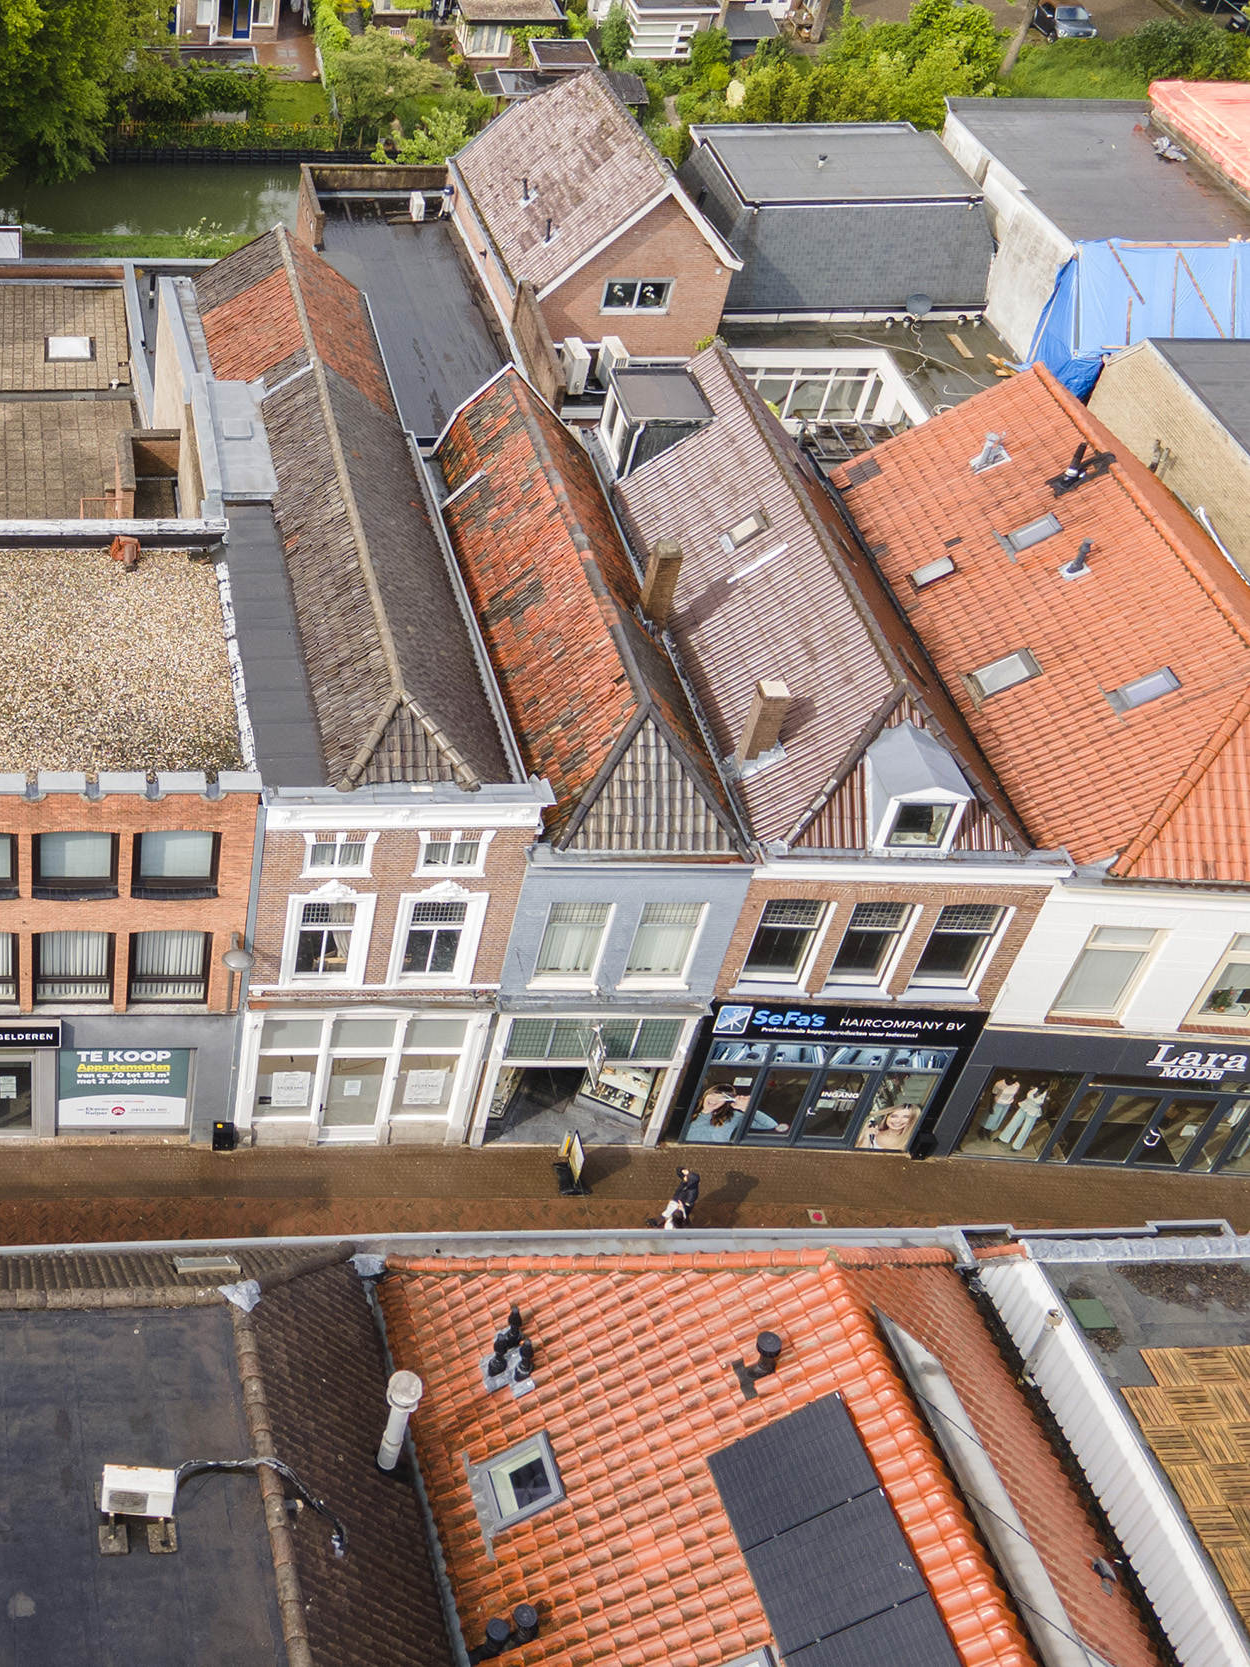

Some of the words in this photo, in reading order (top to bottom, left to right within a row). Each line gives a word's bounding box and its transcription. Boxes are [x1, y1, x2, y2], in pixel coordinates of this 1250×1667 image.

[752, 1010, 826, 1027] SeFa's
[839, 1018, 944, 1030] HAIRCOMPANY
[945, 1022, 966, 1031] BV
[76, 1051, 103, 1062] TE
[108, 1050, 171, 1062] KOOP
[1146, 1043, 1248, 1070] Lara
[76, 1063, 171, 1072] Appartementen
[1158, 1067, 1225, 1080] MODE
[820, 1091, 860, 1099] INGANG
